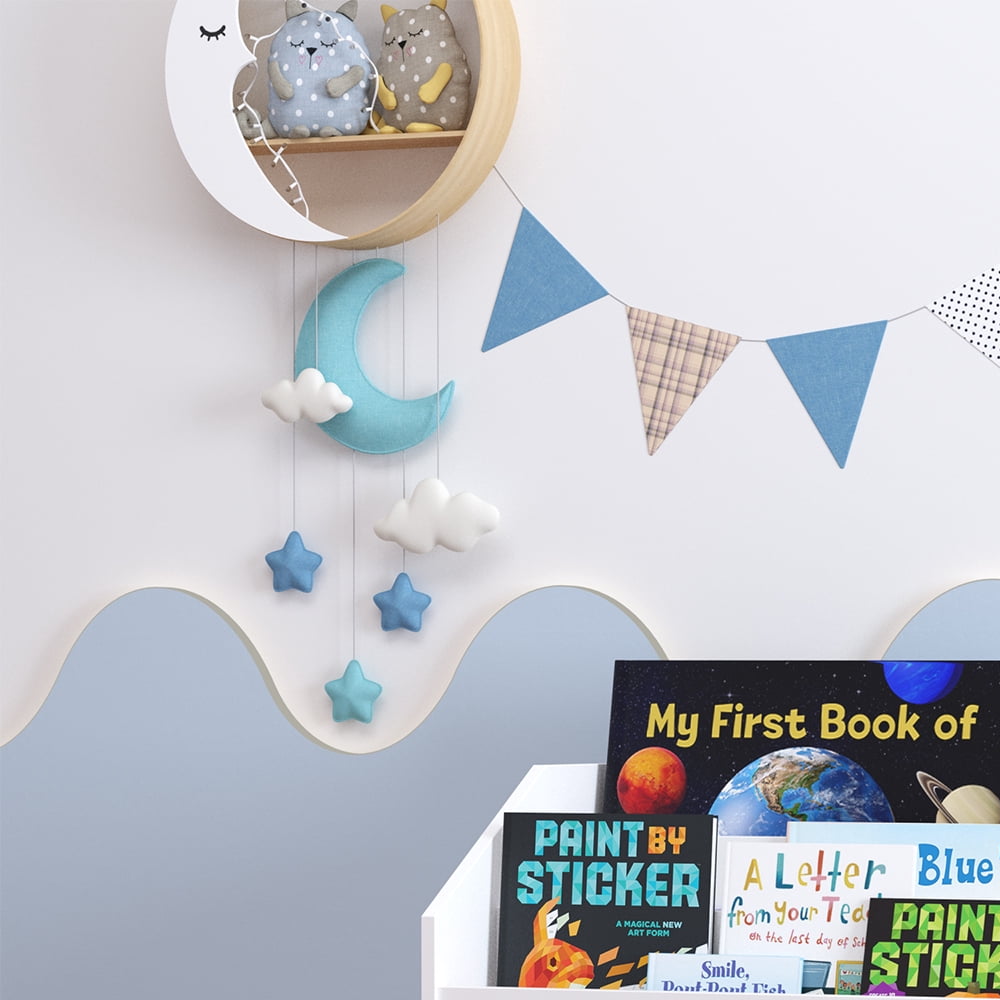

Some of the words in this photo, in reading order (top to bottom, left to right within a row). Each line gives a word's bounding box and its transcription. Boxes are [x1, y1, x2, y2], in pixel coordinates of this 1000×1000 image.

[646, 703, 699, 748] My
[711, 703, 807, 740] First
[820, 703, 920, 742] Book
[934, 704, 980, 740] of
[534, 819, 644, 857] PAINT
[648, 826, 687, 855] BY
[743, 858, 763, 891] A
[775, 850, 886, 892] Letter
[918, 843, 994, 887] Blue
[516, 860, 700, 908] STICKER
[615, 920, 623, 928] A
[624, 920, 661, 929] MAGICAL
[662, 921, 683, 929] NEW
[727, 896, 771, 928] from
[822, 893, 883, 925] Tea
[627, 929, 644, 937] ART
[765, 931, 783, 944] the
[788, 929, 810, 945] last
[816, 932, 833, 949] day
[837, 936, 849, 949] of
[701, 960, 750, 981] Smile,
